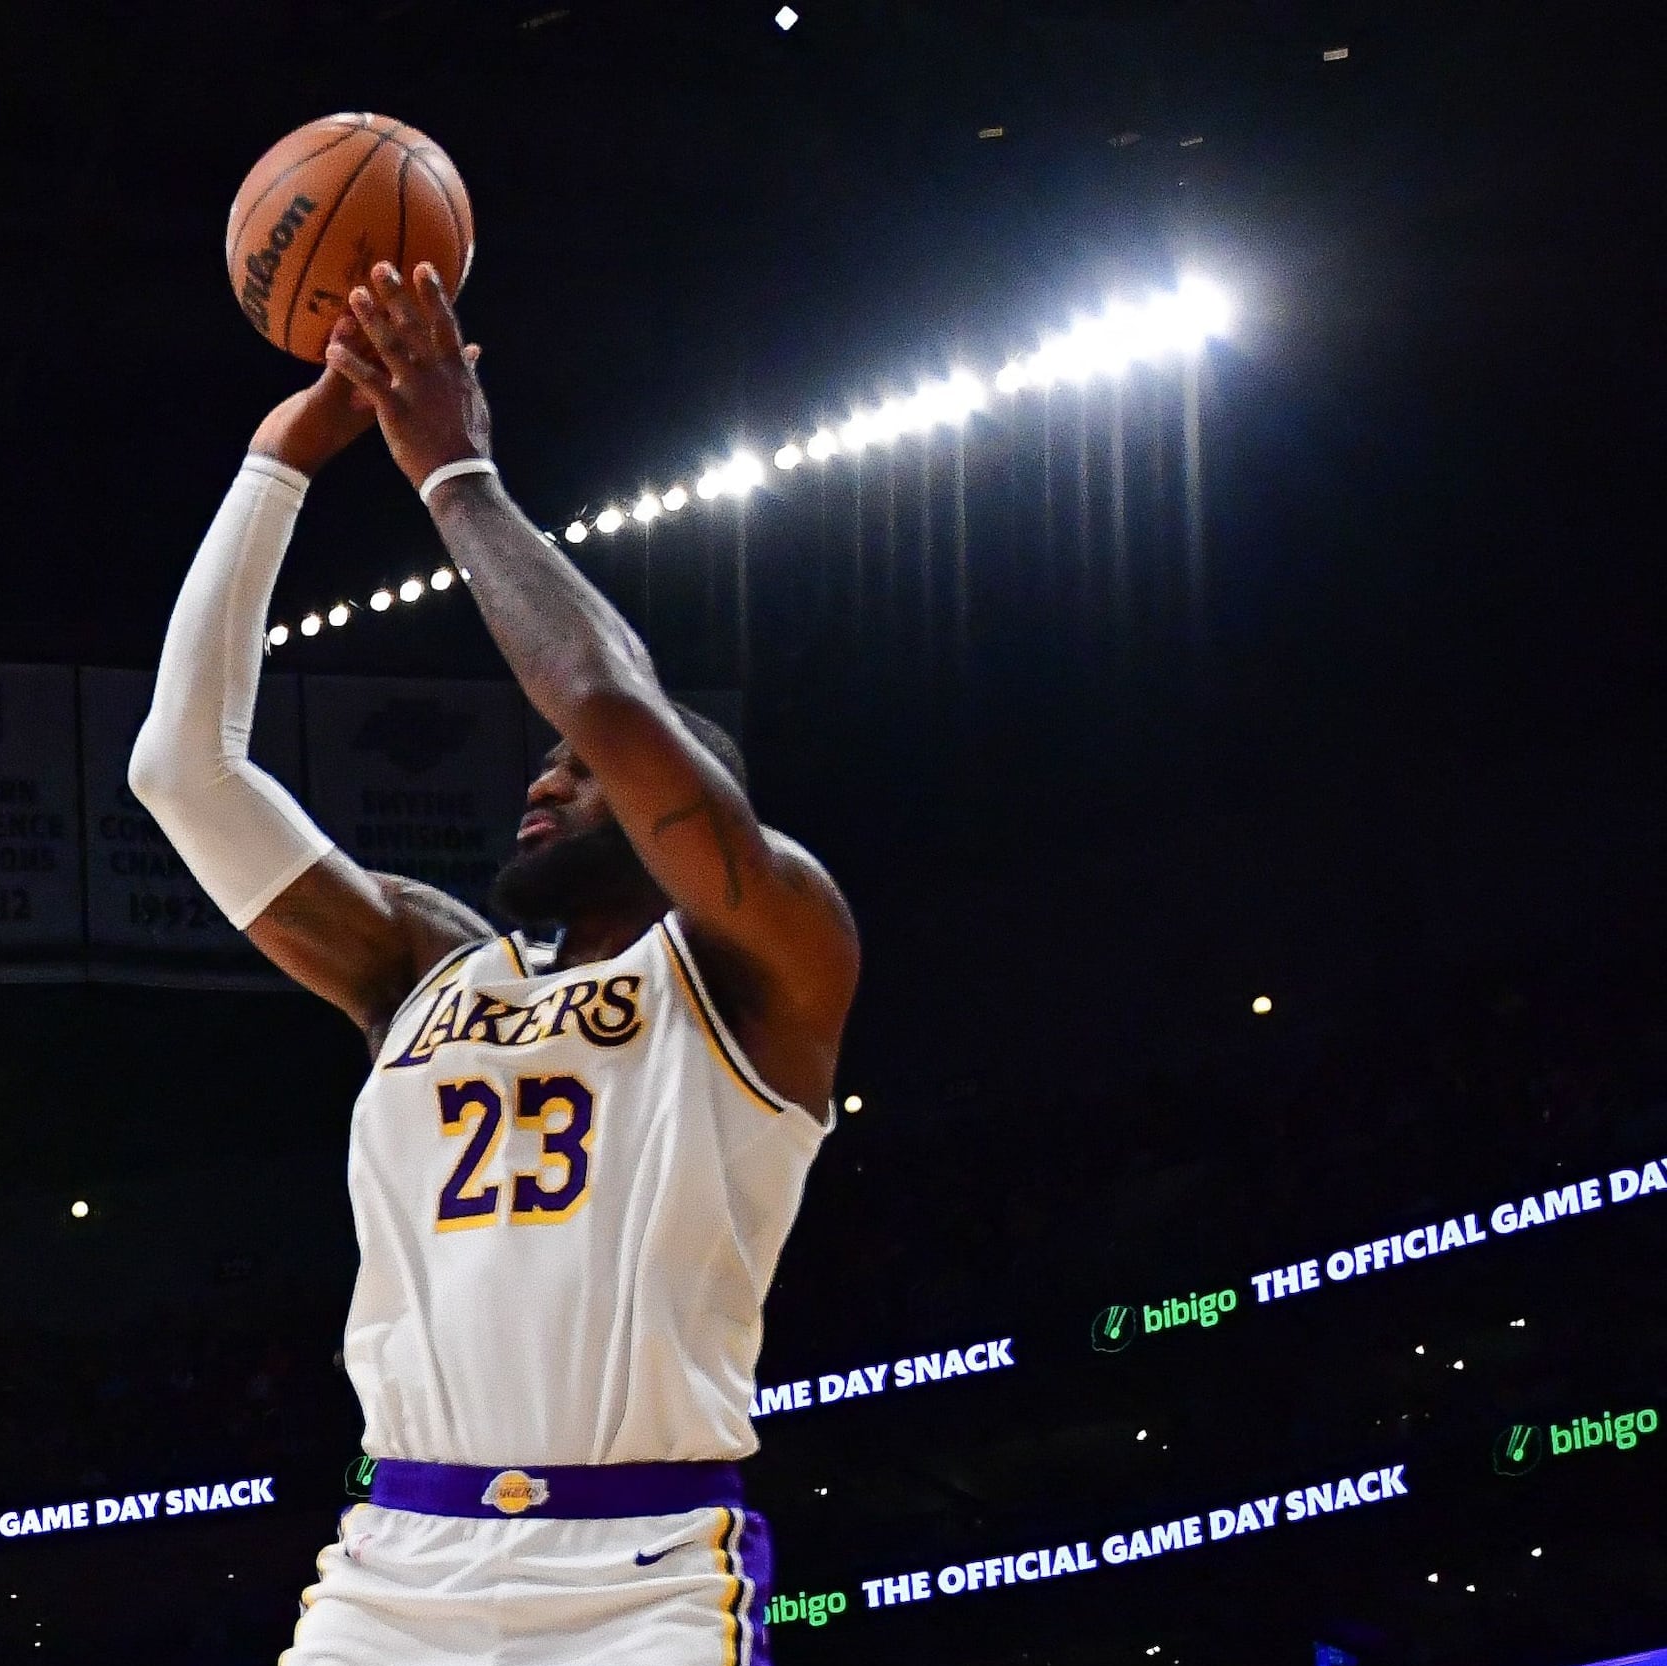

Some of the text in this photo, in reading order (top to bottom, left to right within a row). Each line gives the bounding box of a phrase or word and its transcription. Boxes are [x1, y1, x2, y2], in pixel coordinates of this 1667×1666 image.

[383, 975, 643, 1072] LAKERS
[434, 1072, 595, 1233] 23
[1251, 1158, 1667, 1302] THE OFFICIAL GAME DA
[1144, 1290, 1236, 1332] bibigo
[819, 1364, 889, 1403] DAY
[894, 1338, 1014, 1387] SNACK
[1551, 1409, 1657, 1454] bibigo
[0, 1502, 90, 1537] GAME
[96, 1492, 161, 1525] DAY
[165, 1477, 275, 1515] SNACK
[862, 1464, 1408, 1608] THE OFFICIAL GAME DAY SNACK
